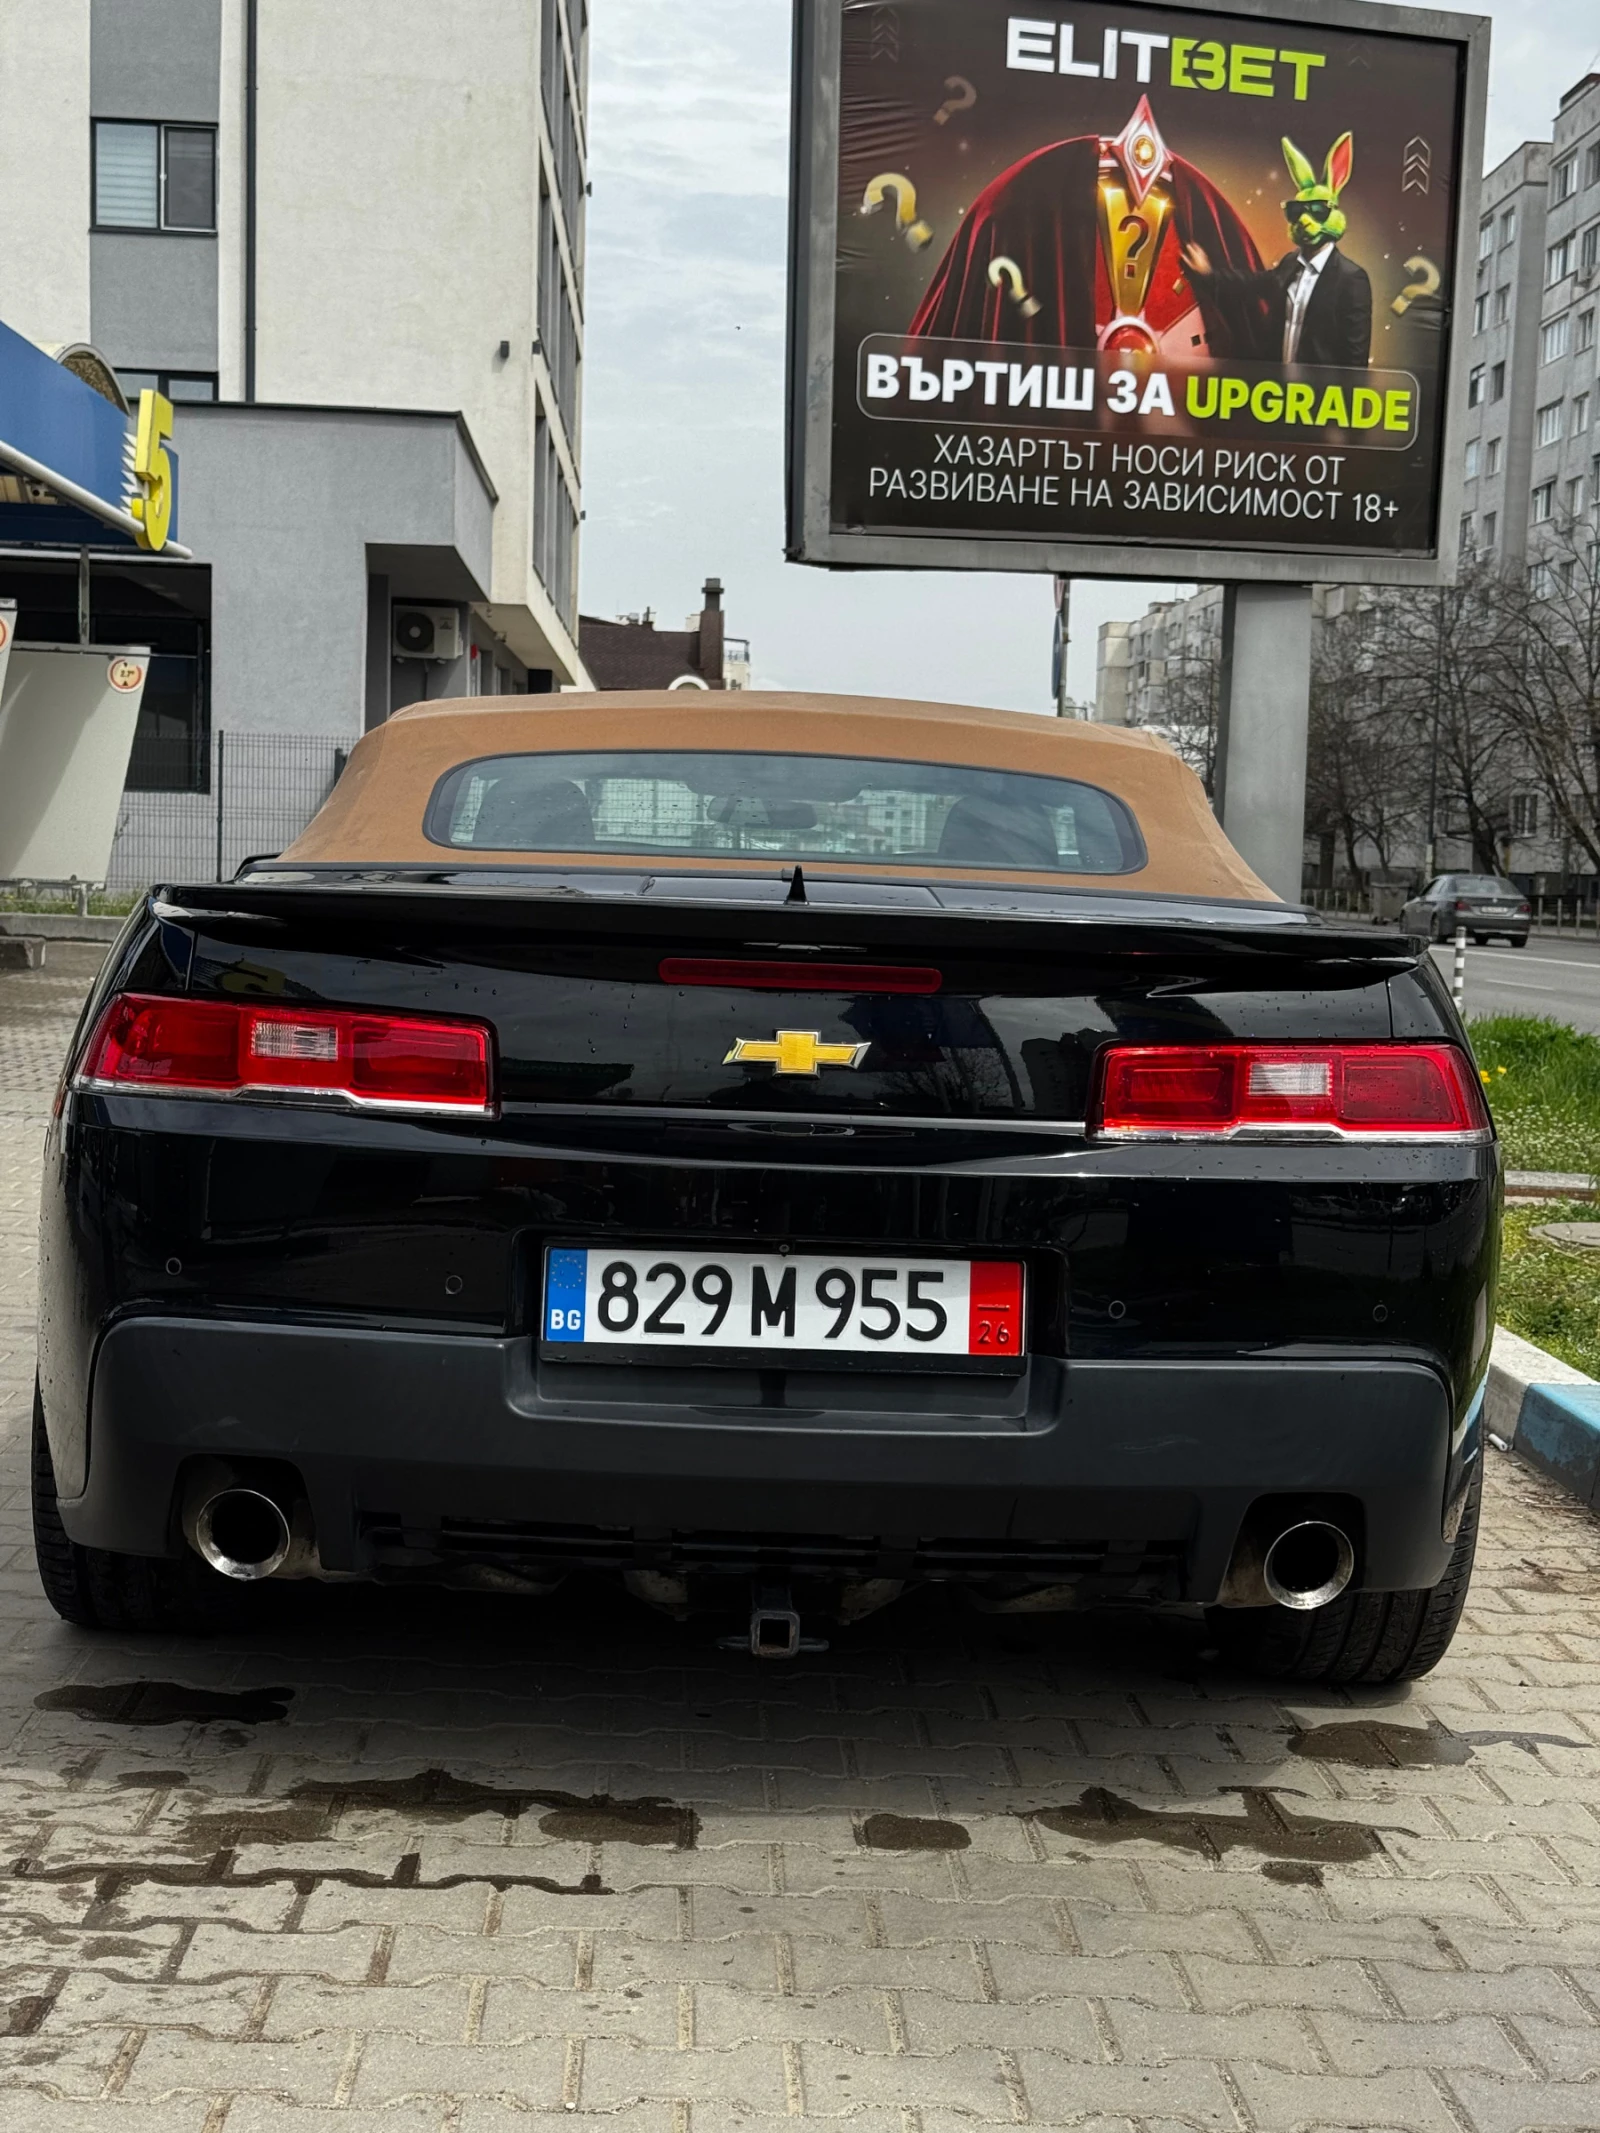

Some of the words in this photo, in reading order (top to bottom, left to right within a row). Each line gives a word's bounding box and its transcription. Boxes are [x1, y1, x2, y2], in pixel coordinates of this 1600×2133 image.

[1006, 16, 1326, 101] ELITBET
[866, 353, 1095, 411] ВЪРТИШ
[1107, 370, 1175, 417] ЗА
[1186, 376, 1411, 432] UPGRADE
[933, 433, 1102, 472] ХАЗАРТЪТ
[1111, 443, 1204, 478] НОСИ
[1213, 449, 1297, 483] РИСК
[1304, 455, 1346, 486] ОТ
[868, 467, 1060, 506] РАЗВИВАНЕ
[1070, 477, 1114, 508] НА
[1122, 480, 1344, 521] ЗАВИСИМОСТ
[1351, 493, 1400, 523] 18+
[550, 1308, 582, 1331] BG
[597, 1260, 733, 1335] 829
[751, 1265, 797, 1338] M
[815, 1268, 948, 1342] 955
[977, 1320, 1011, 1345] 26
